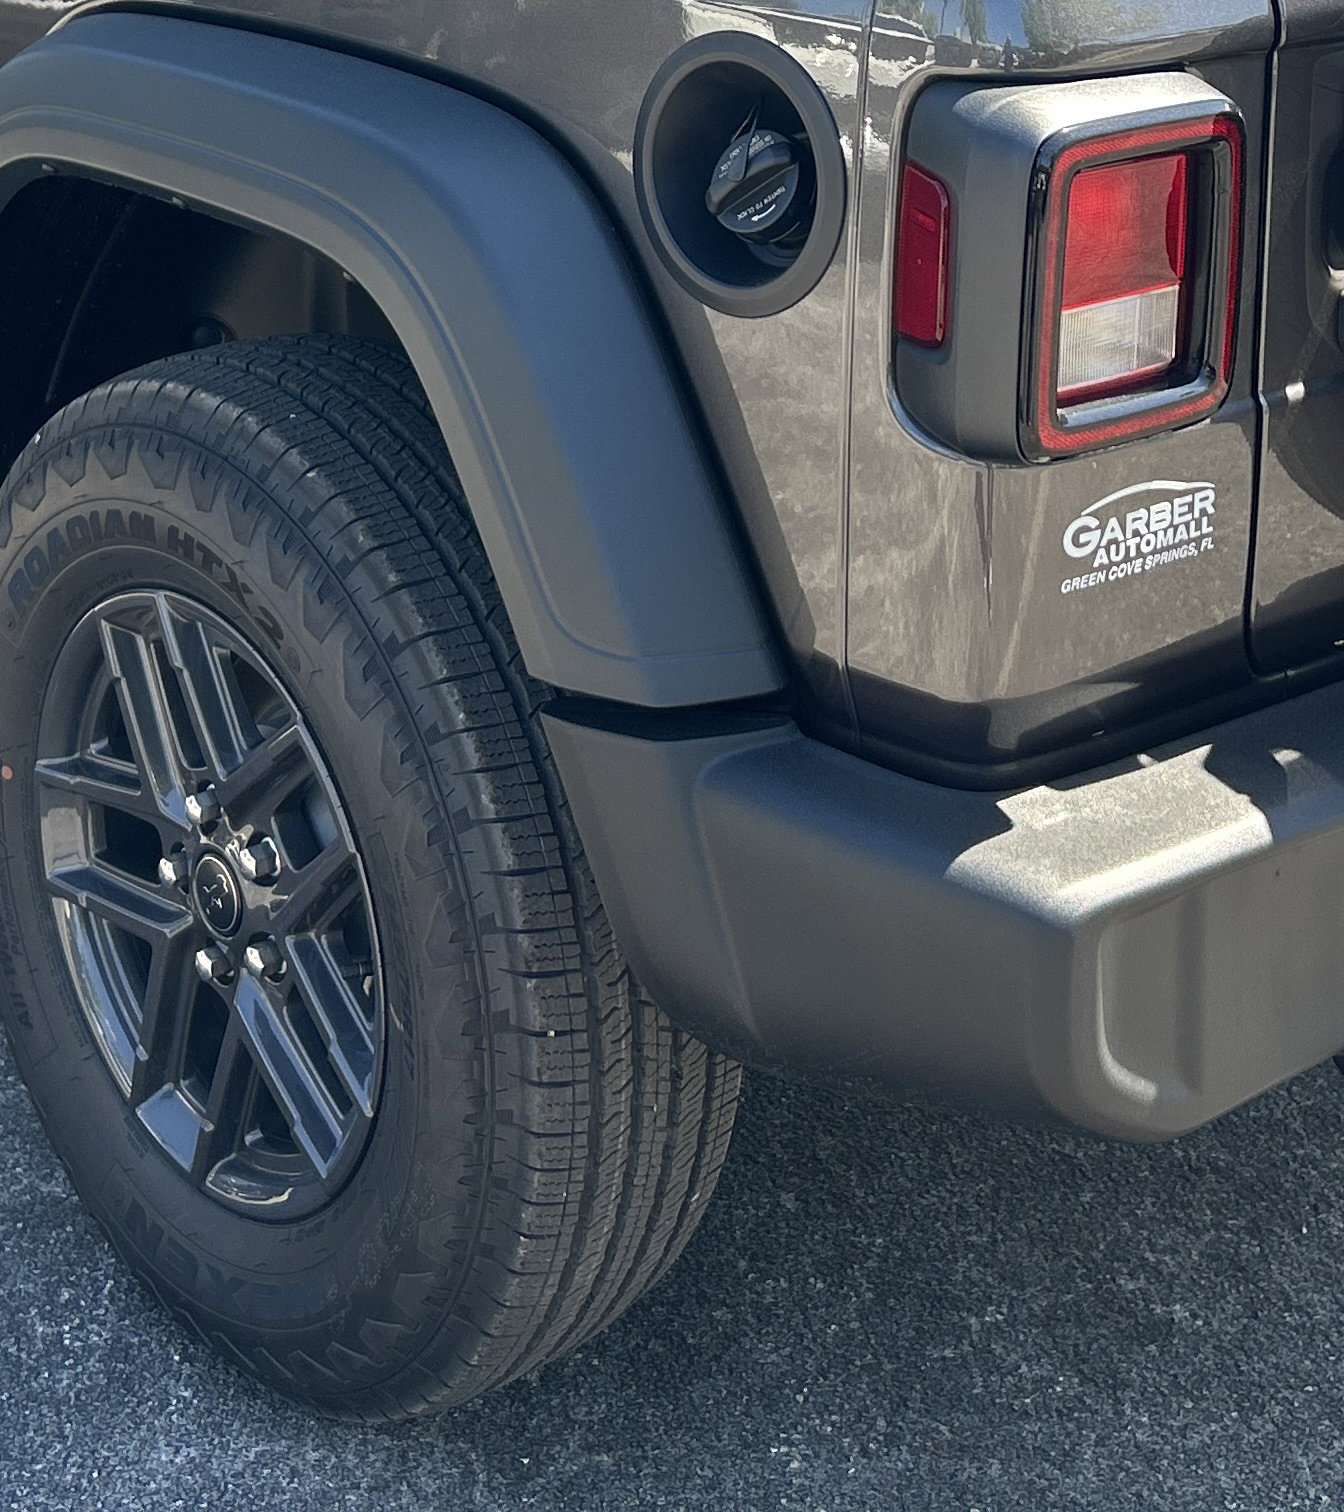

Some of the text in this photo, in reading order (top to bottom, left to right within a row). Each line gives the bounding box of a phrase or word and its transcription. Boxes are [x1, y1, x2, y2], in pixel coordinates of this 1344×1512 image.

[1063, 489, 1215, 558] GARBER
[1093, 516, 1214, 568] AUTOMALL
[8, 509, 157, 614] ROADIAN
[1060, 537, 1214, 594] GREEN COVE SPRINGS, FL
